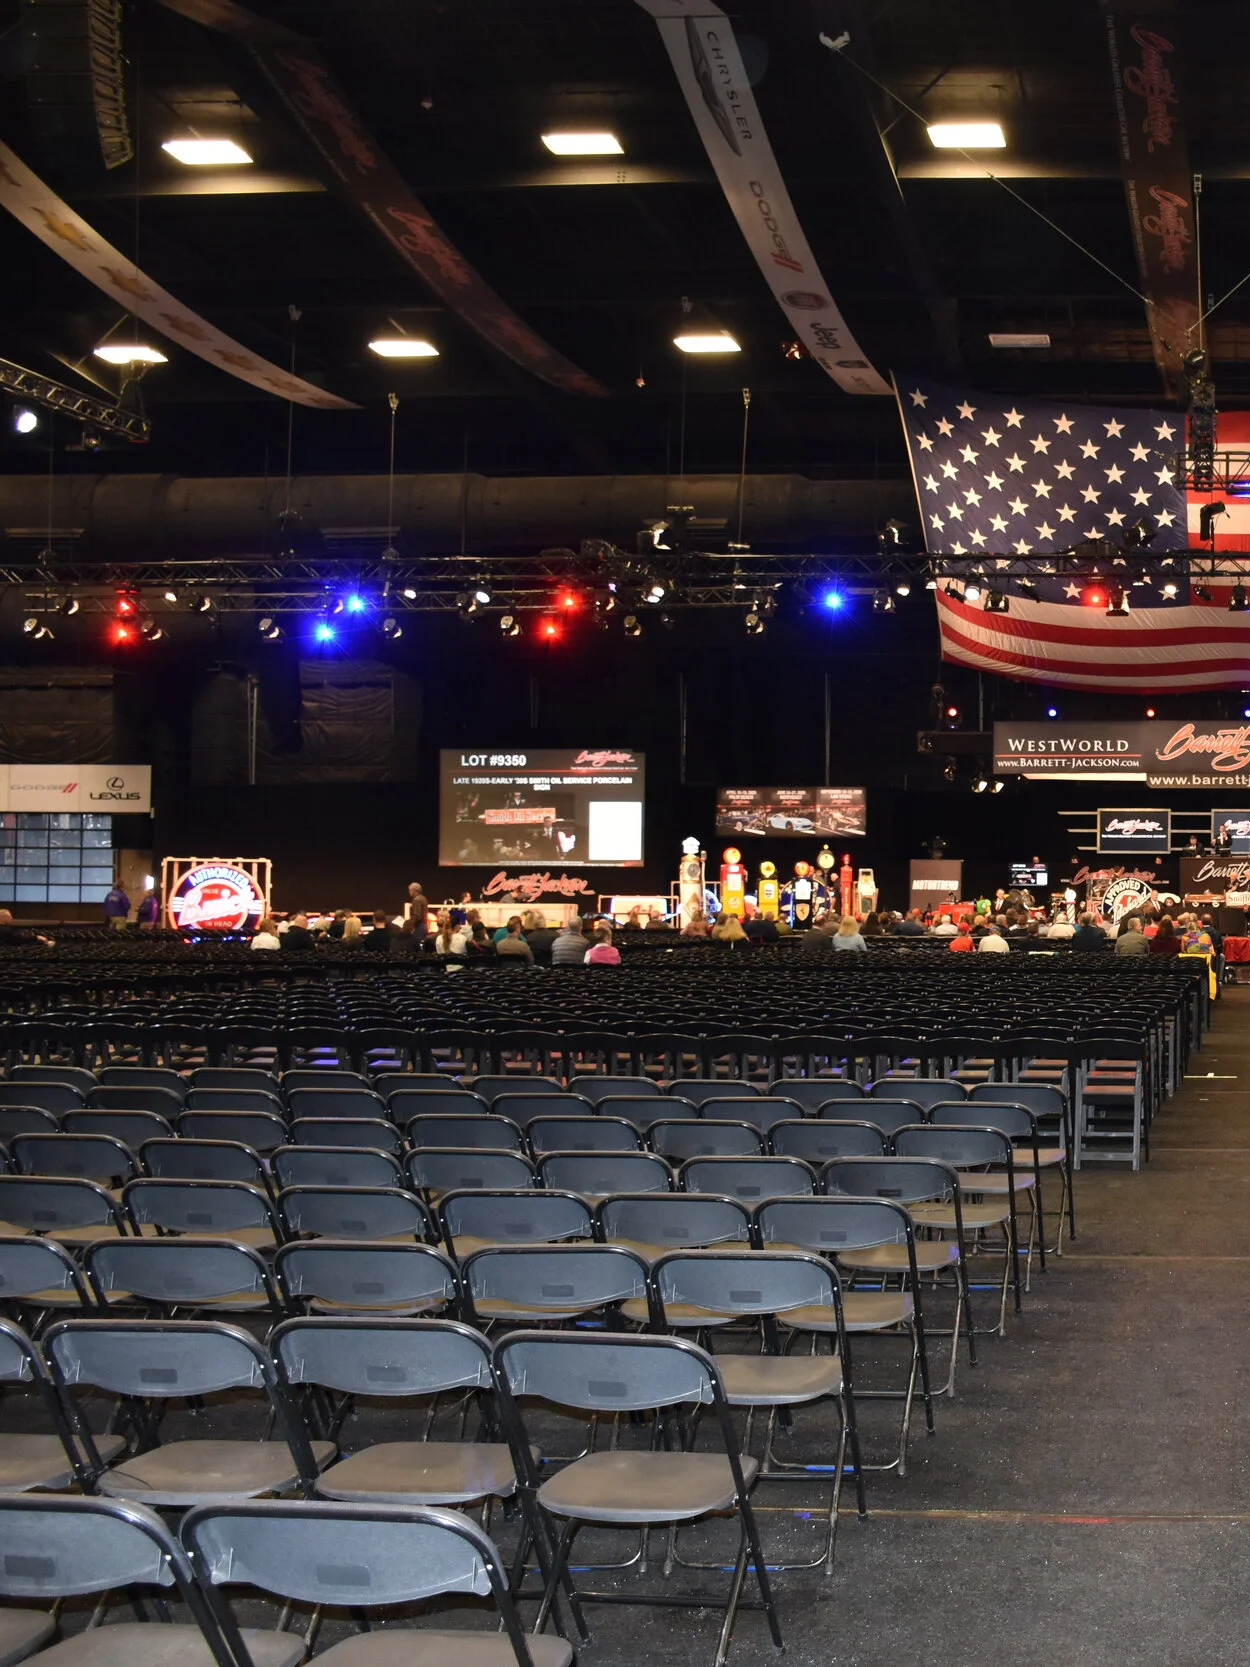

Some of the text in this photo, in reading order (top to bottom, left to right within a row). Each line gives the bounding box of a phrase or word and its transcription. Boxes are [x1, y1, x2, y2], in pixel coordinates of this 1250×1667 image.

[707, 31, 753, 141] CHRYSLER
[748, 180, 792, 261] DODGE
[809, 322, 842, 349] Jeep
[1008, 739, 1129, 752] WESTWORLD
[461, 755, 527, 766] LOT #9350
[89, 792, 141, 800] LEXUS
[188, 866, 250, 889] AUTHORIZED
[912, 880, 959, 891] MOTORTREND
[1103, 881, 1141, 906] APPROVED
